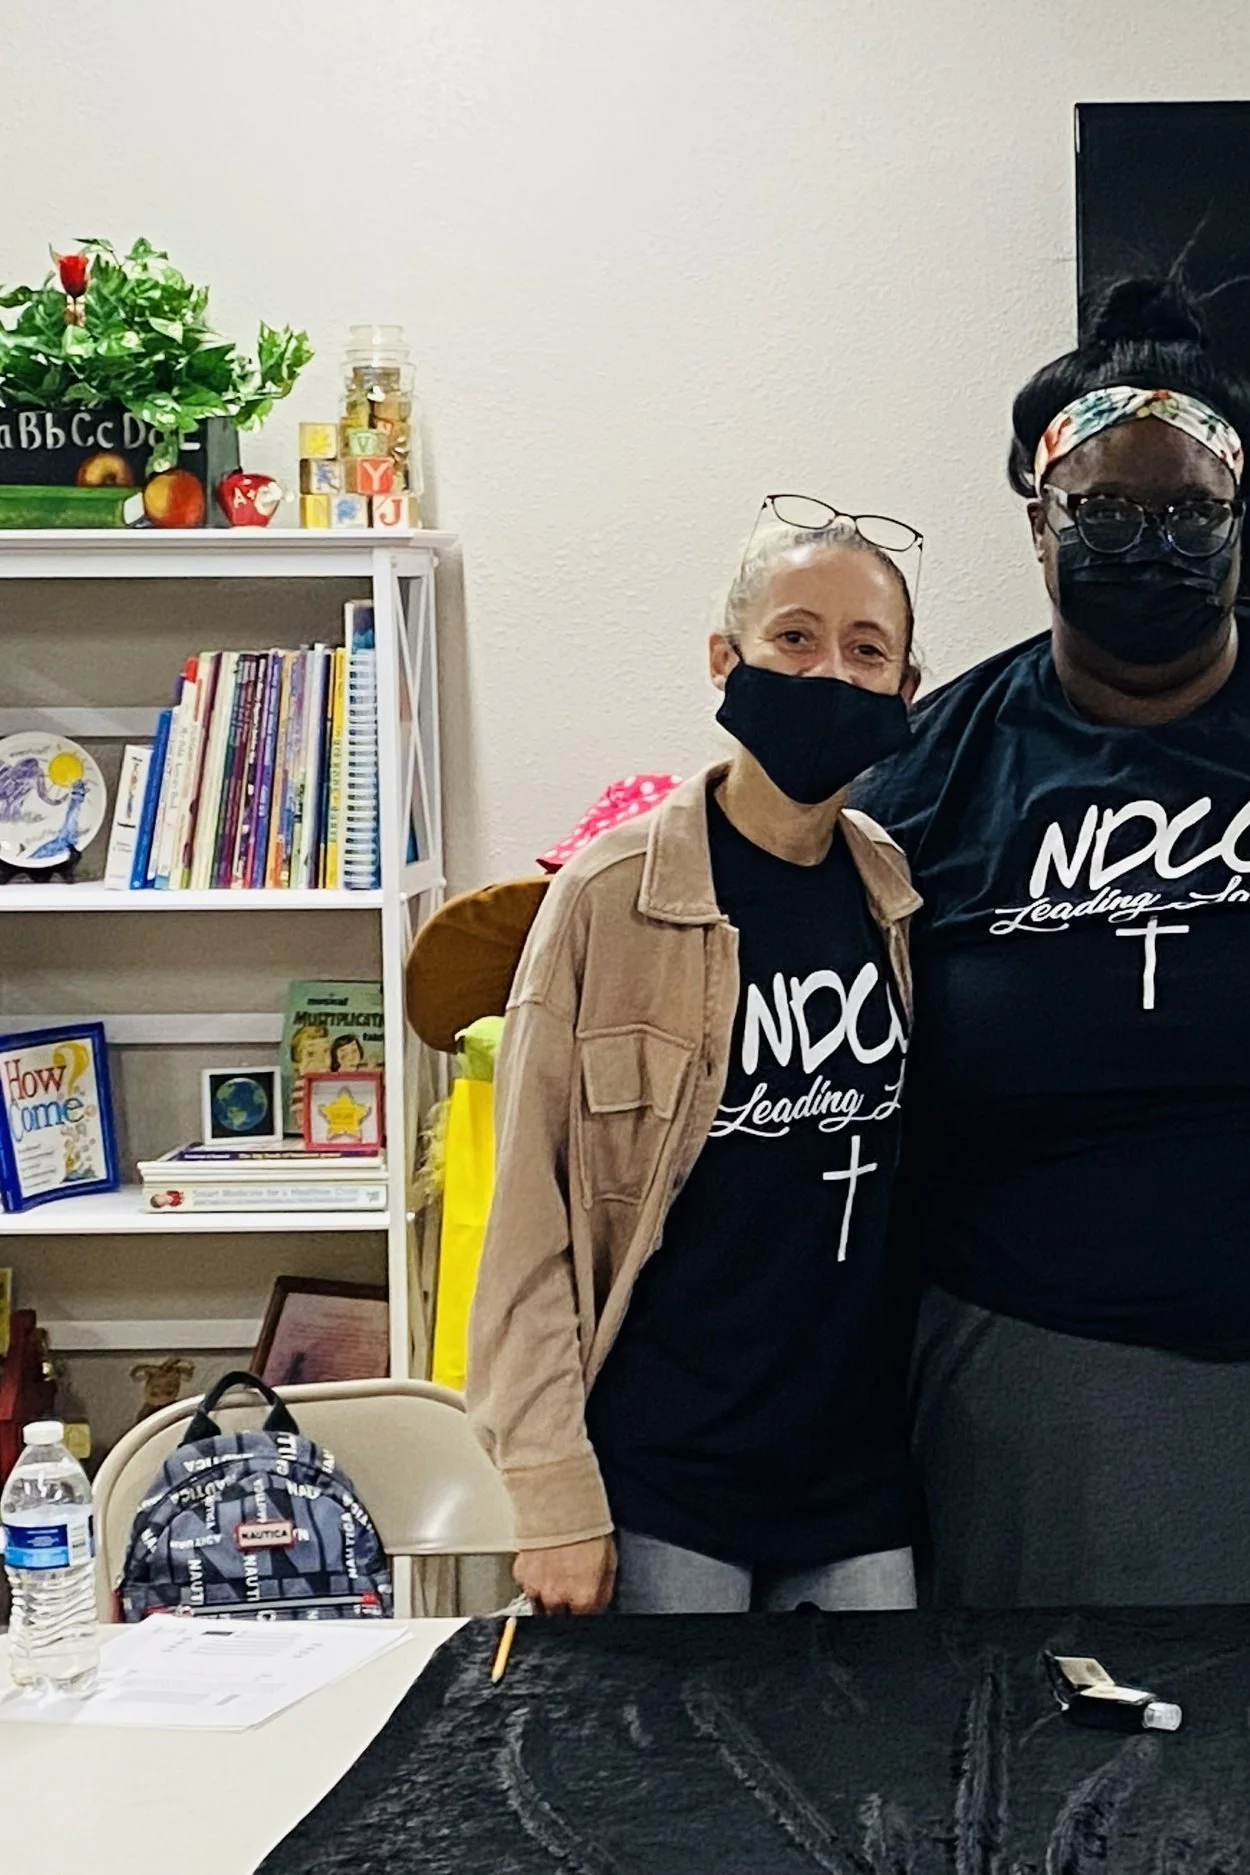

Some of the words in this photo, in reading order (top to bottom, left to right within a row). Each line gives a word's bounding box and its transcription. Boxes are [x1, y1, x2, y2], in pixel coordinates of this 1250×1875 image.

[362, 461, 390, 493] Y
[379, 499, 403, 526] J
[989, 886, 1162, 935] Leading
[4, 1058, 67, 1102] How
[9, 1097, 85, 1143] Come
[708, 1075, 865, 1138] Leading
[241, 1529, 289, 1541] NAUTICA
